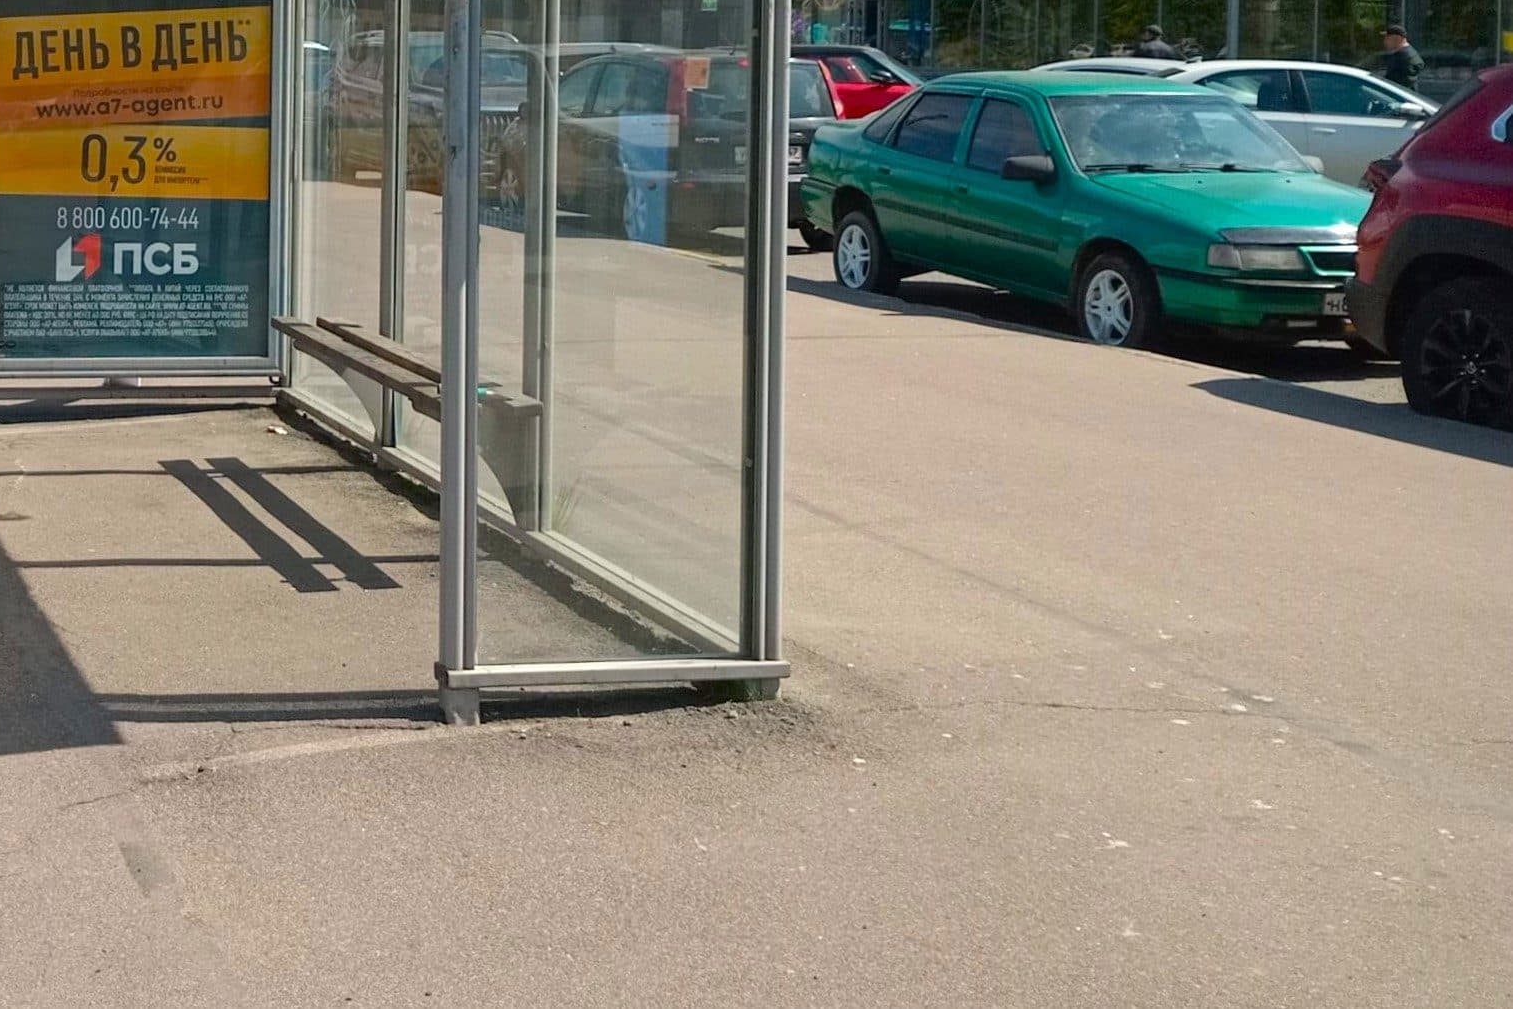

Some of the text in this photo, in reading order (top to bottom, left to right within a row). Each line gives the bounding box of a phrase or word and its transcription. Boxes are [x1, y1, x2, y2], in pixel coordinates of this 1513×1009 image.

[13, 28, 109, 80] ДЕНЬ
[120, 25, 142, 68] В
[36, 94, 223, 118] www.a7-agent.ru
[57, 207, 199, 230] 8 800 600-74-44
[113, 243, 199, 275] ПСБ
